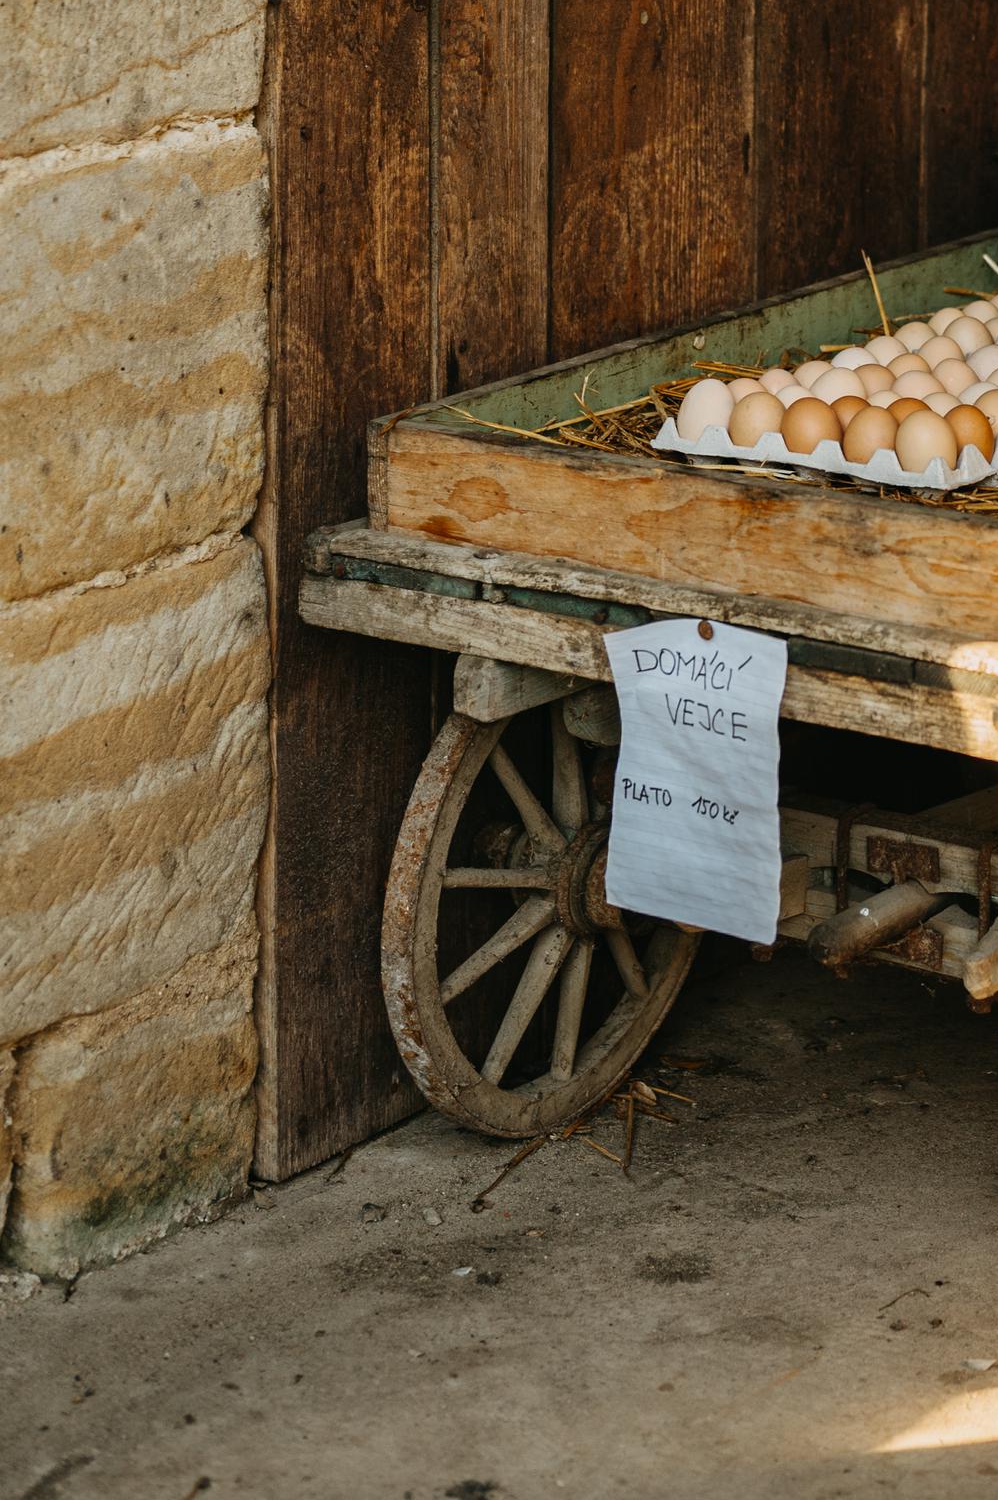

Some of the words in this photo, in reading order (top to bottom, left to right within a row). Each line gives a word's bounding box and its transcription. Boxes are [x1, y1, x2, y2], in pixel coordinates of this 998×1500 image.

[665, 693, 748, 742] VEJCE
[622, 778, 672, 807] PLATO
[691, 796, 719, 819] 150
